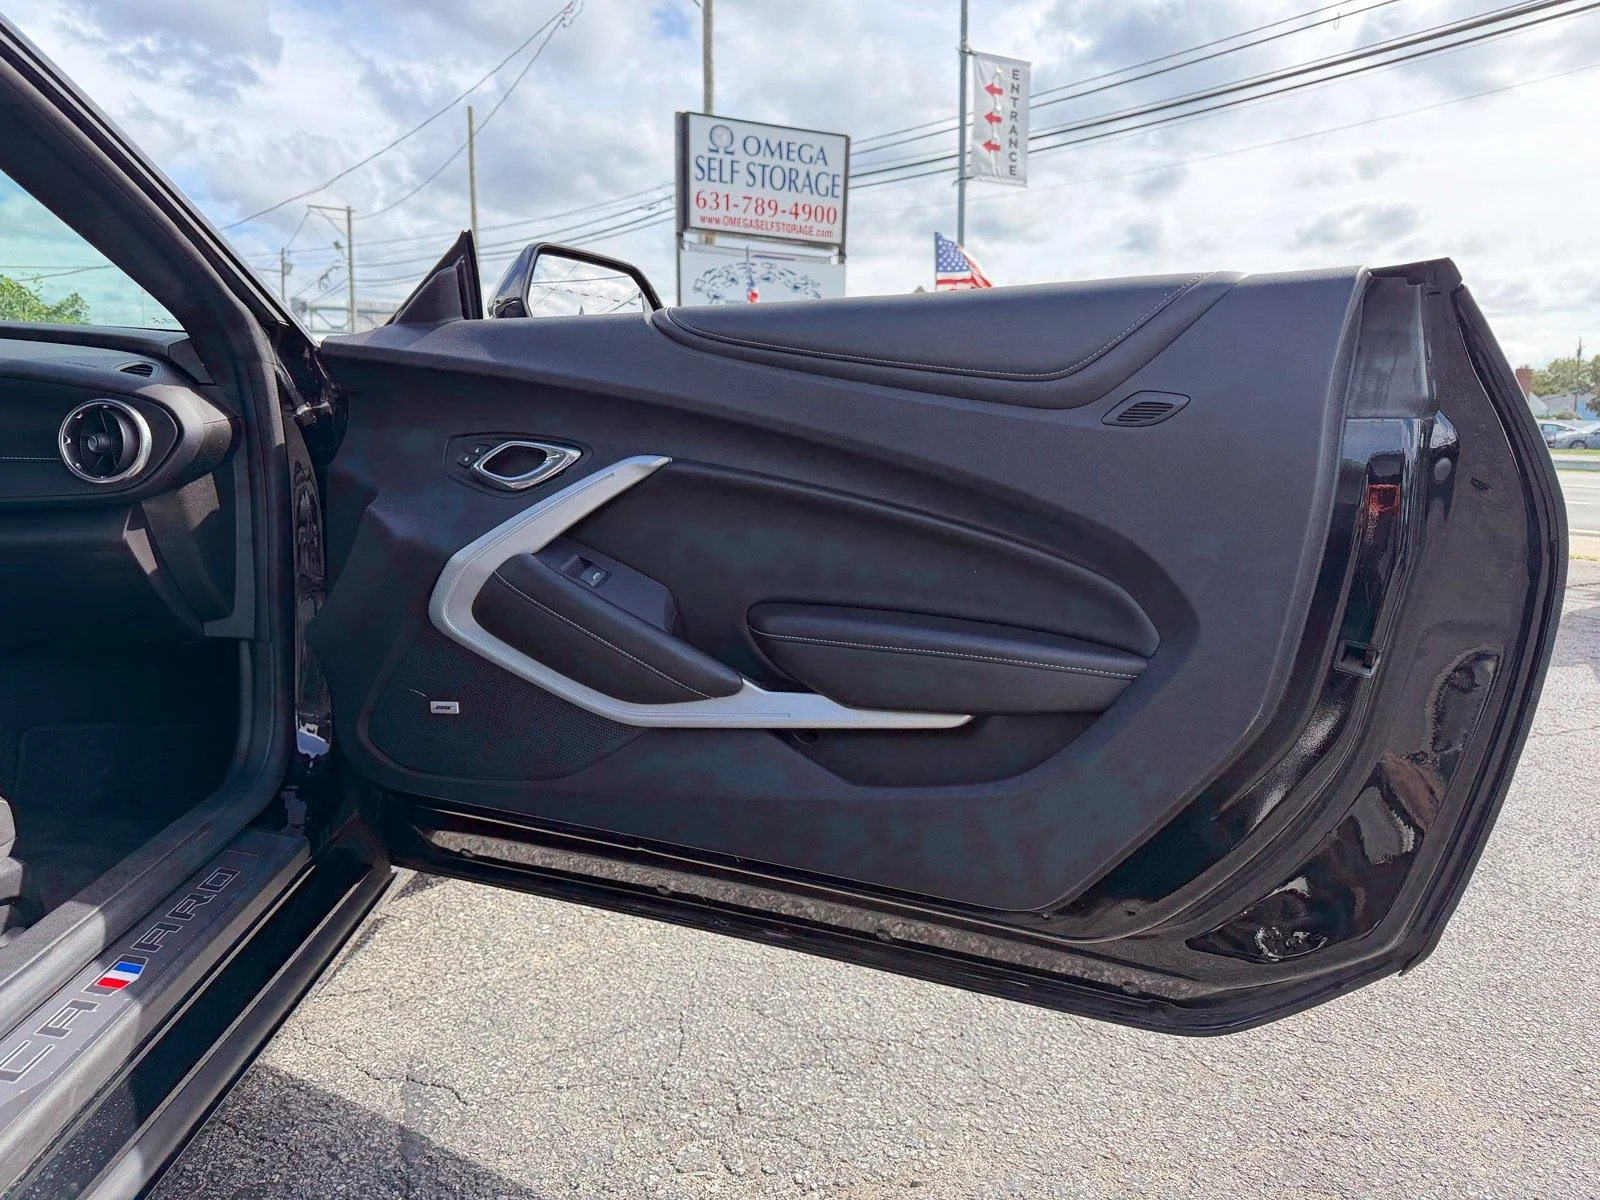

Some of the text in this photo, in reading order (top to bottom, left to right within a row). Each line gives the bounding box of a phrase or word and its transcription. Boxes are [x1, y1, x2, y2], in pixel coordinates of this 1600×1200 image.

[1009, 69, 1020, 176] ENTRANCE
[743, 135, 828, 167] OMEGA
[695, 155, 841, 199] SELF STORAGE
[695, 190, 837, 225] 631-789-4900
